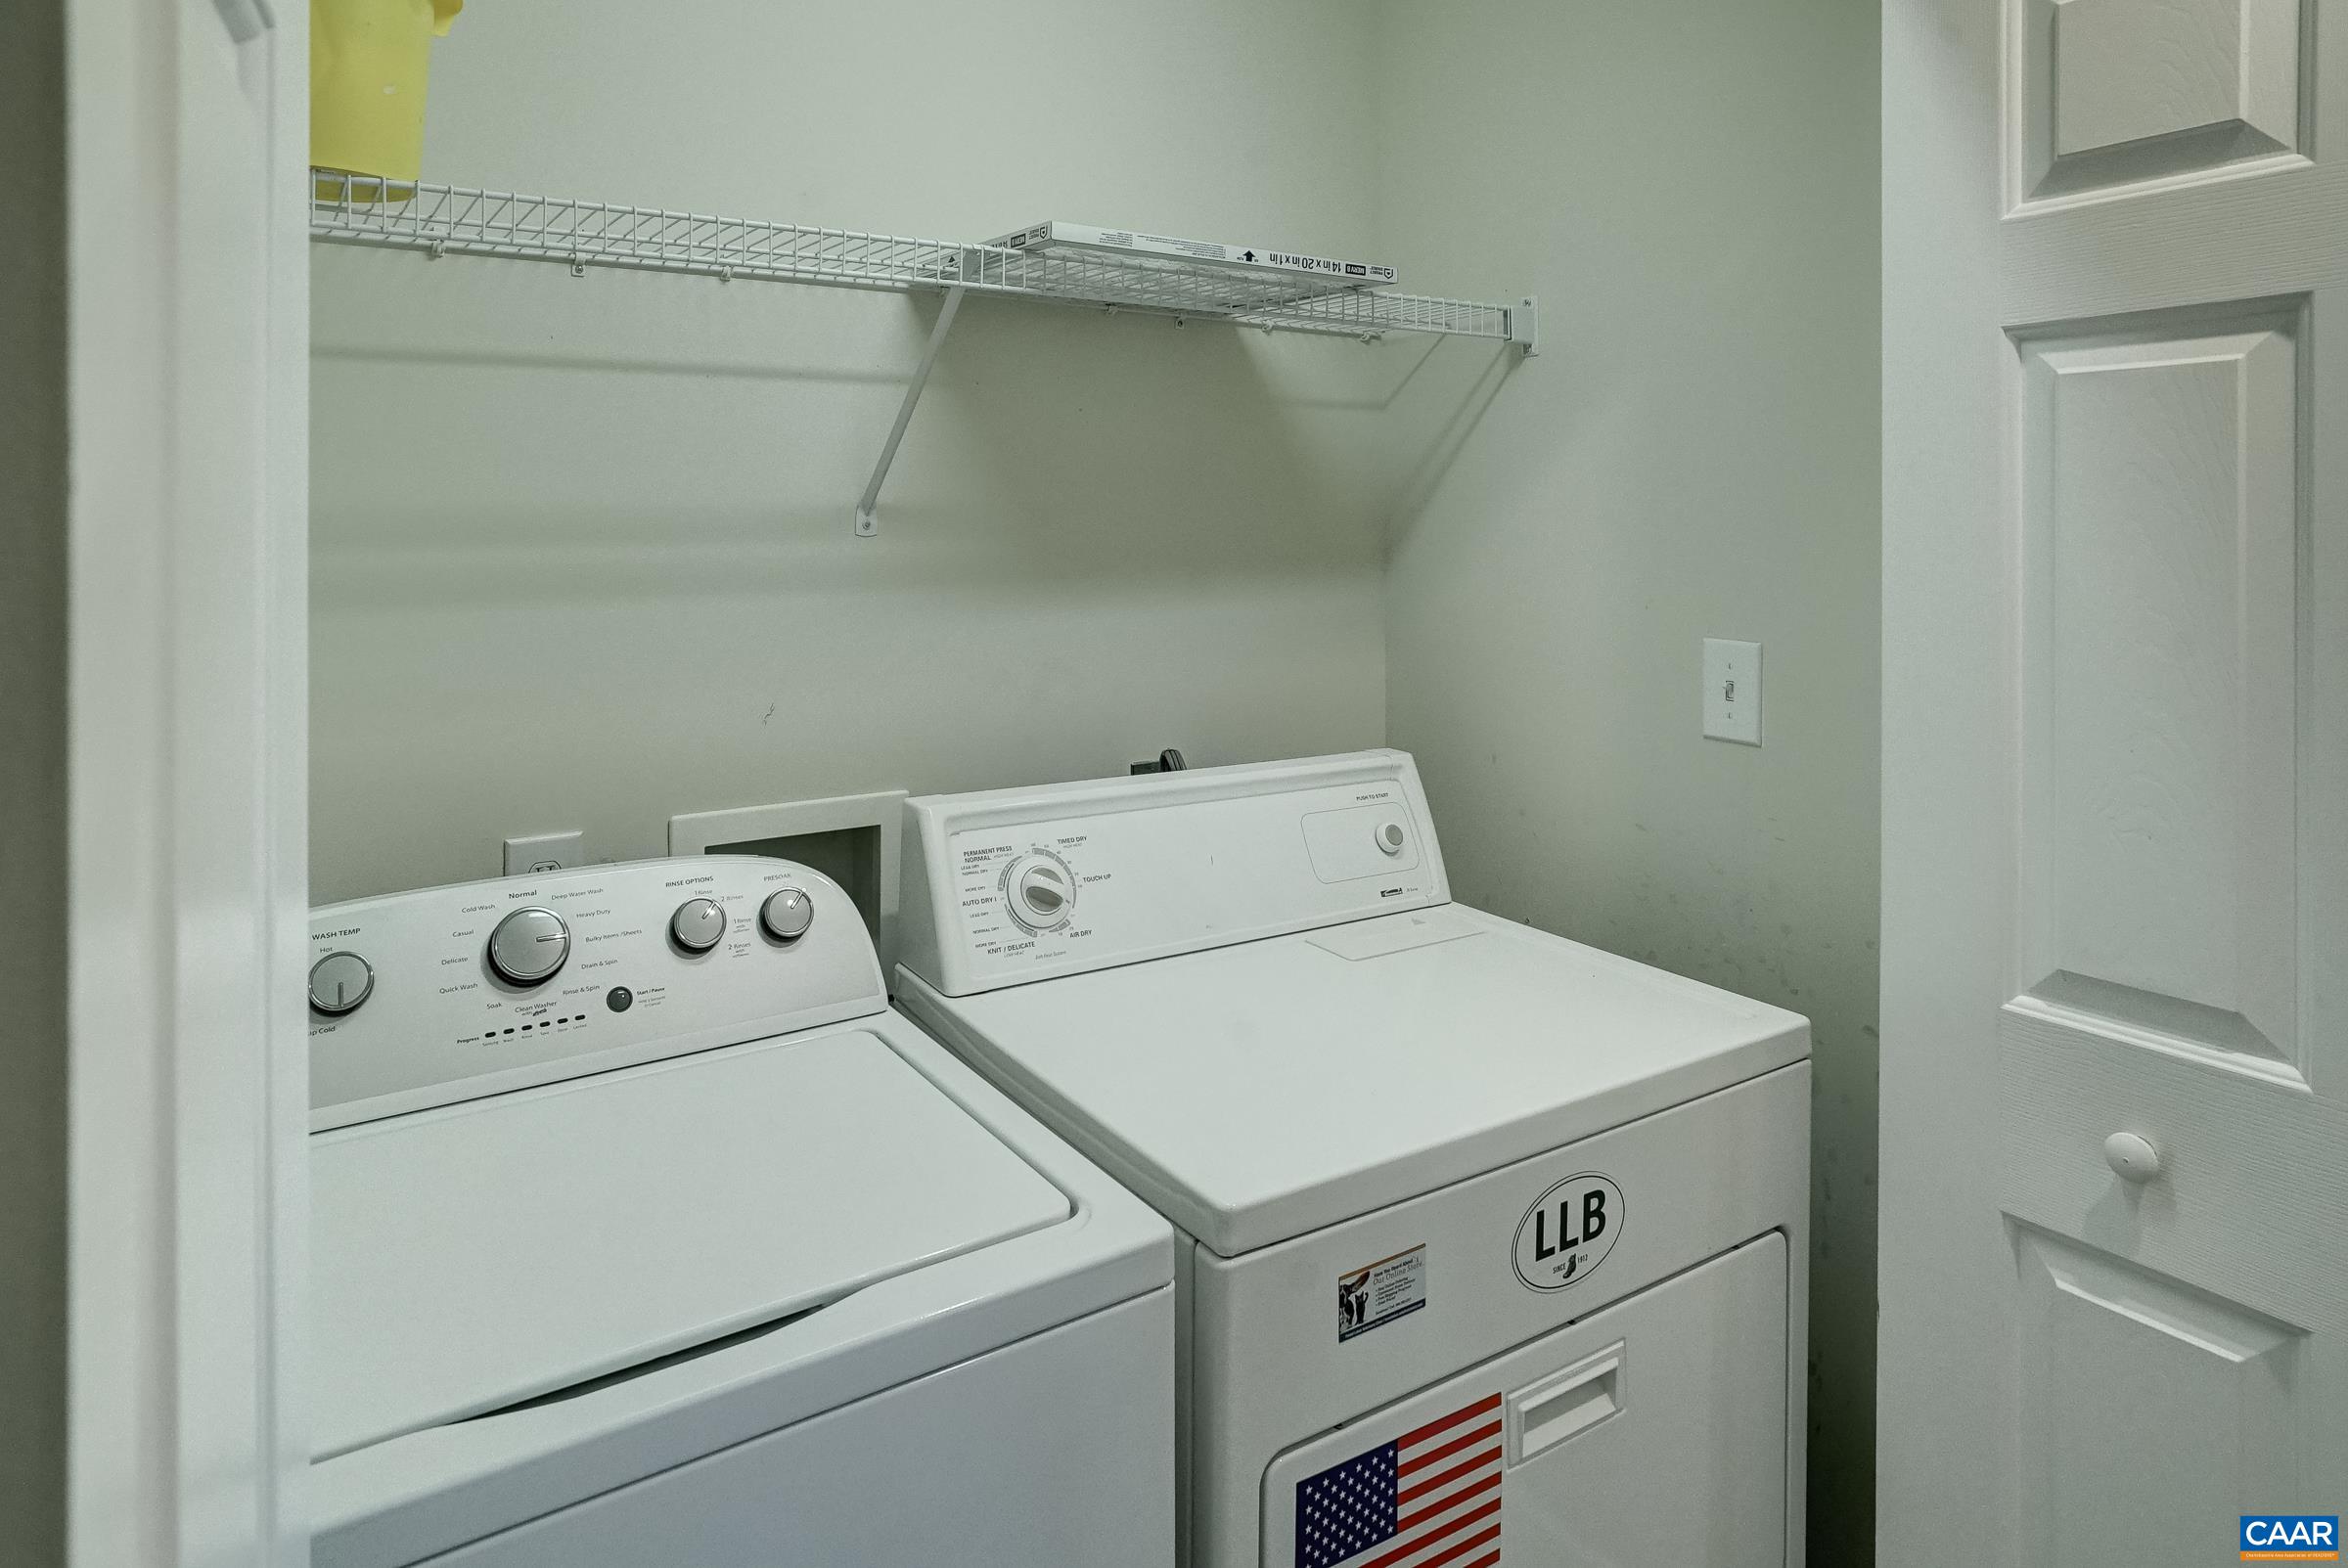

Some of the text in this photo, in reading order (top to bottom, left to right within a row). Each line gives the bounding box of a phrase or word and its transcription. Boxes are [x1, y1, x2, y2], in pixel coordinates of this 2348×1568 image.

[1269, 253, 1278, 264] in
[1280, 254, 1283, 265] 1
[1286, 254, 1290, 264] x
[1291, 256, 1300, 267] in
[1301, 257, 1314, 270] 20
[1316, 259, 1321, 268] x
[1323, 260, 1331, 271] in
[1332, 261, 1341, 273] 14
[964, 848, 995, 857] PERMANENT
[685, 875, 714, 885] OPTIONS
[509, 890, 537, 899] Normal
[462, 905, 476, 914] Cold
[1008, 941, 1035, 952] DELICATE
[441, 957, 469, 965] Delicate
[515, 1005, 533, 1013] Clean
[534, 1001, 558, 1009] Washer
[1535, 1188, 1606, 1263] LLB
[1553, 1263, 1565, 1274] SINCE
